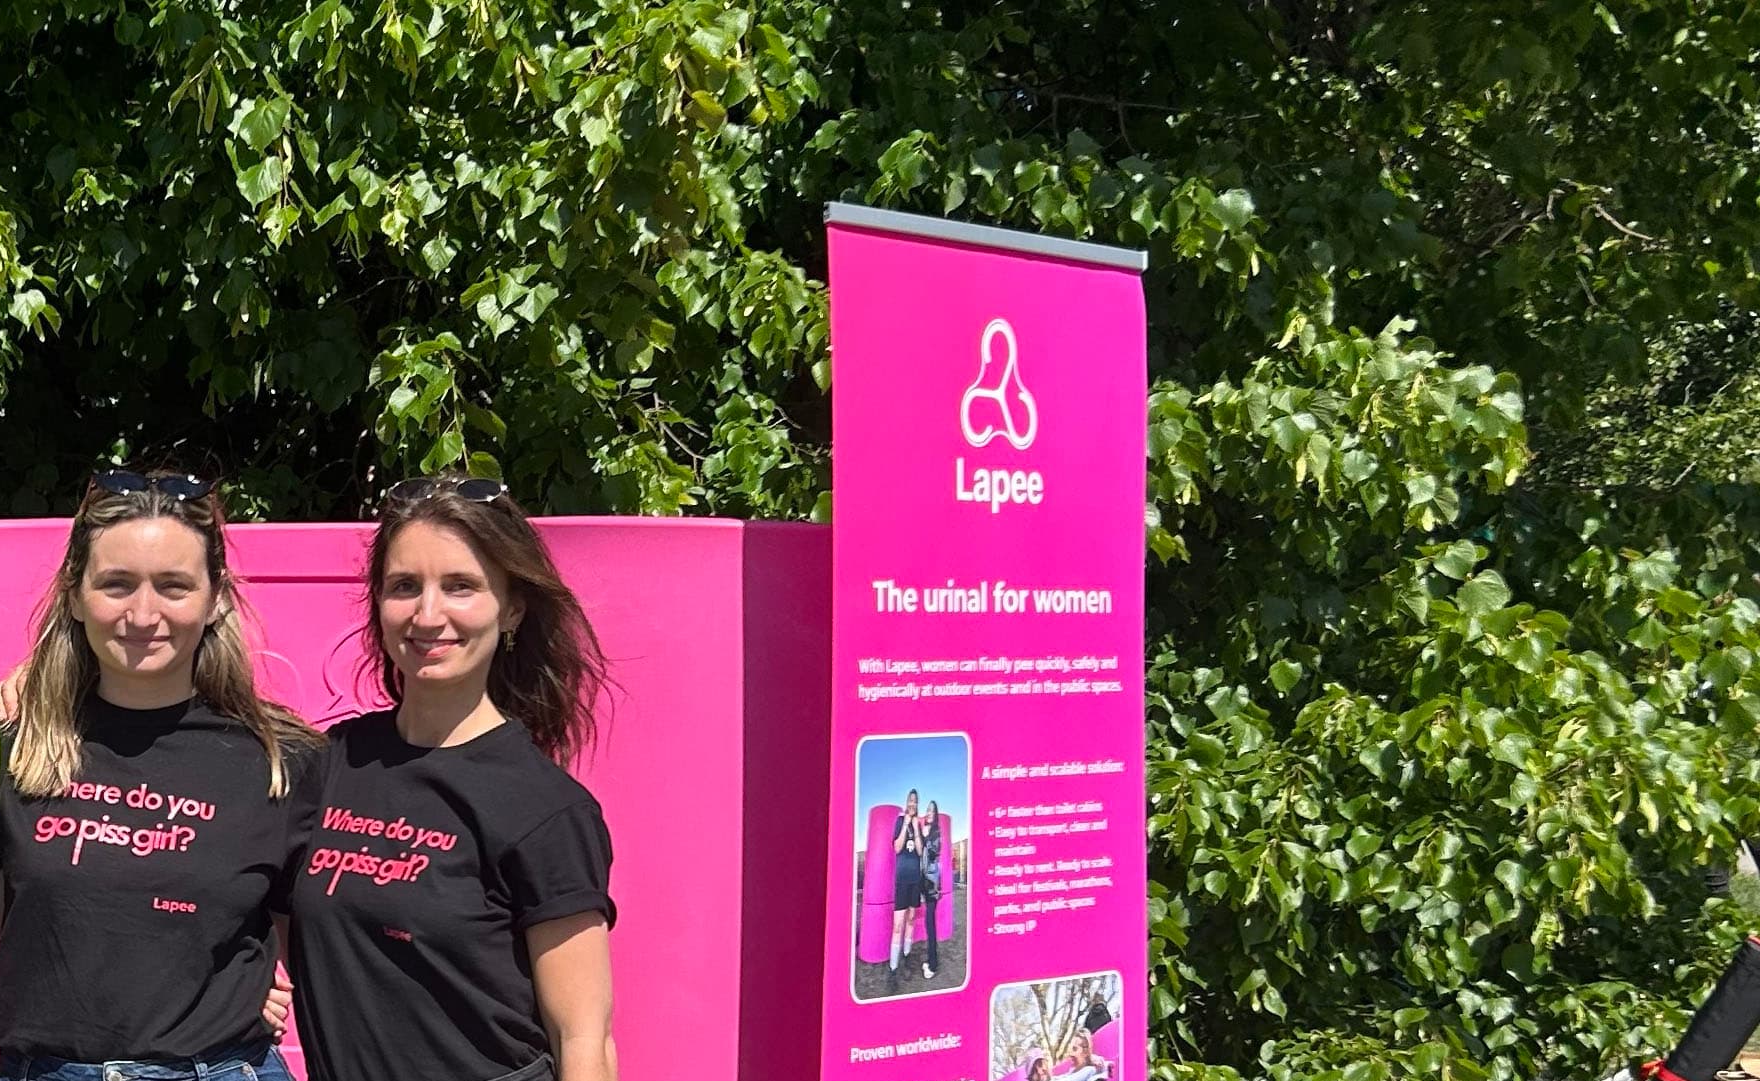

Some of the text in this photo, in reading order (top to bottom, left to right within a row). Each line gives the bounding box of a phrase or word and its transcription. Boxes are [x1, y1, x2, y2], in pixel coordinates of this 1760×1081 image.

[956, 456, 1044, 514] Lapee
[872, 579, 1112, 614] The urinal for women
[859, 658, 885, 673] With
[885, 659, 920, 675] Lapee,
[921, 661, 959, 672] women
[960, 661, 978, 672] can
[979, 656, 1012, 674] finally
[1013, 660, 1034, 673] pee
[1071, 656, 1100, 672] safely
[1100, 656, 1118, 669] and
[858, 683, 920, 701] hygienically
[920, 684, 933, 696] at
[933, 682, 972, 695] outdoor
[972, 683, 1008, 695] events
[1009, 680, 1032, 694] and
[1032, 679, 1043, 693] in
[1043, 680, 1060, 693] the
[1060, 679, 1091, 696] public
[981, 766, 991, 779] A
[991, 764, 1028, 780] simple
[1028, 763, 1049, 777] and
[63, 781, 216, 820] here do you
[35, 814, 196, 866] go piss girl?
[322, 807, 458, 851] Where do you
[308, 848, 341, 875] go
[326, 846, 382, 896] piss
[153, 897, 197, 914] Lapee
[850, 1033, 961, 1063] Proven worldwide:
